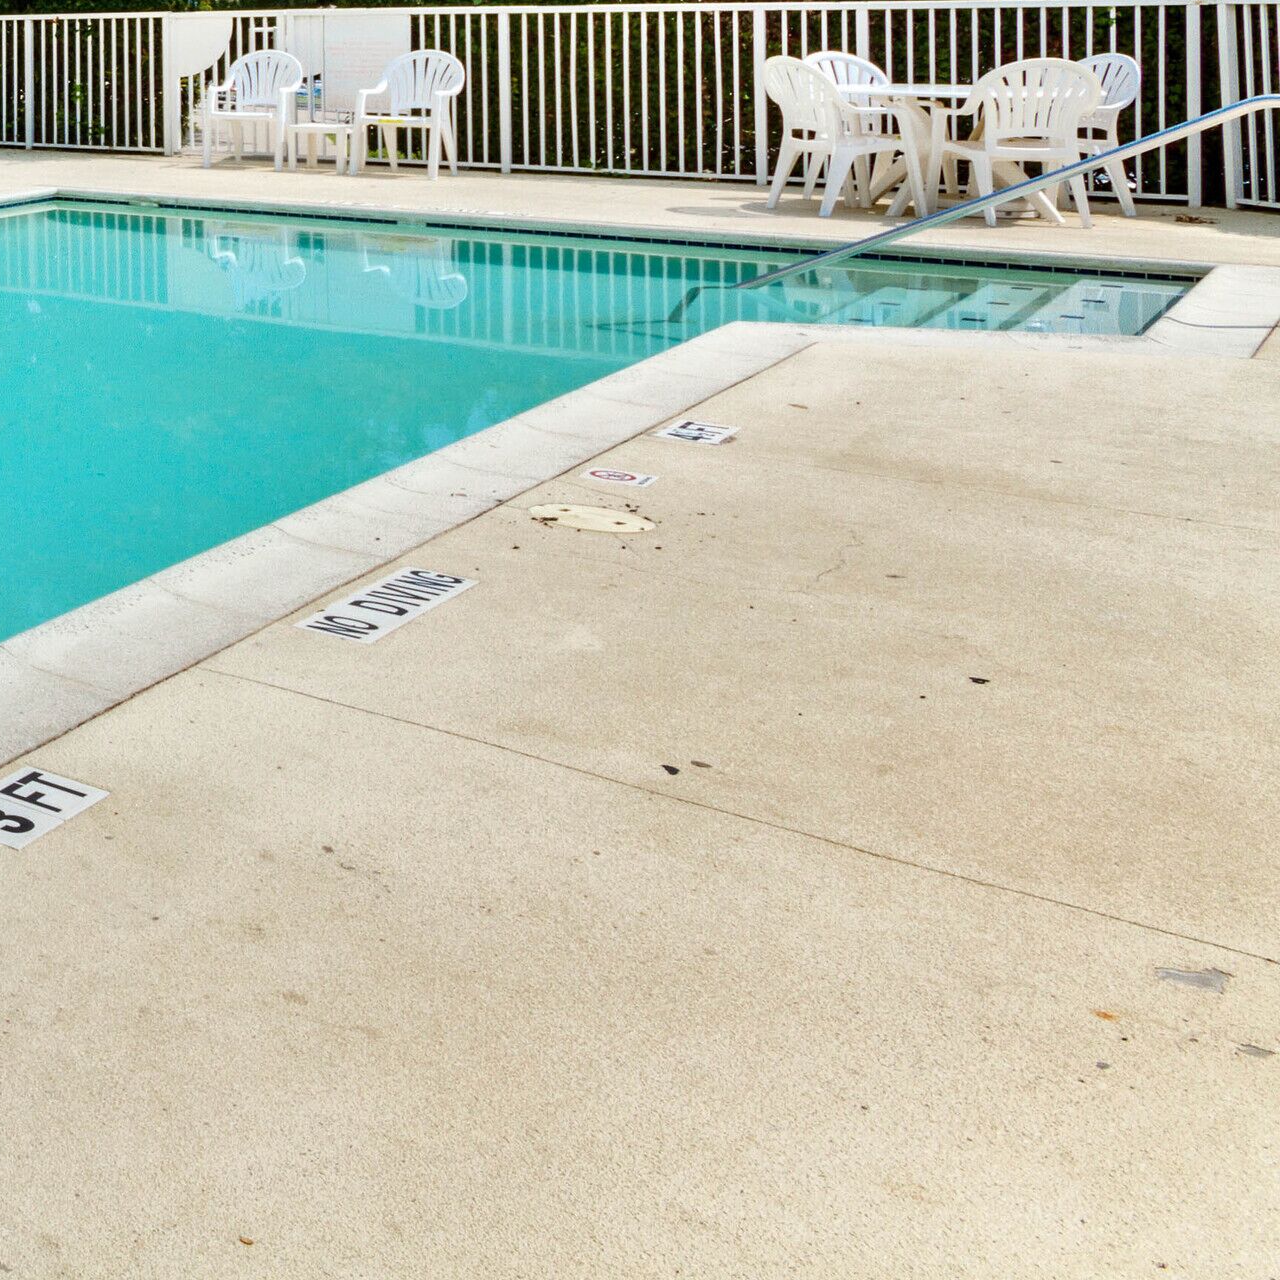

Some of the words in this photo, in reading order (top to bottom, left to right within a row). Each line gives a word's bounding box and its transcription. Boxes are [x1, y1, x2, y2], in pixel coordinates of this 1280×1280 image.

[680, 421, 729, 434] FT
[307, 615, 378, 638] NO
[348, 570, 464, 616] DIVING
[0, 770, 88, 813] FT
